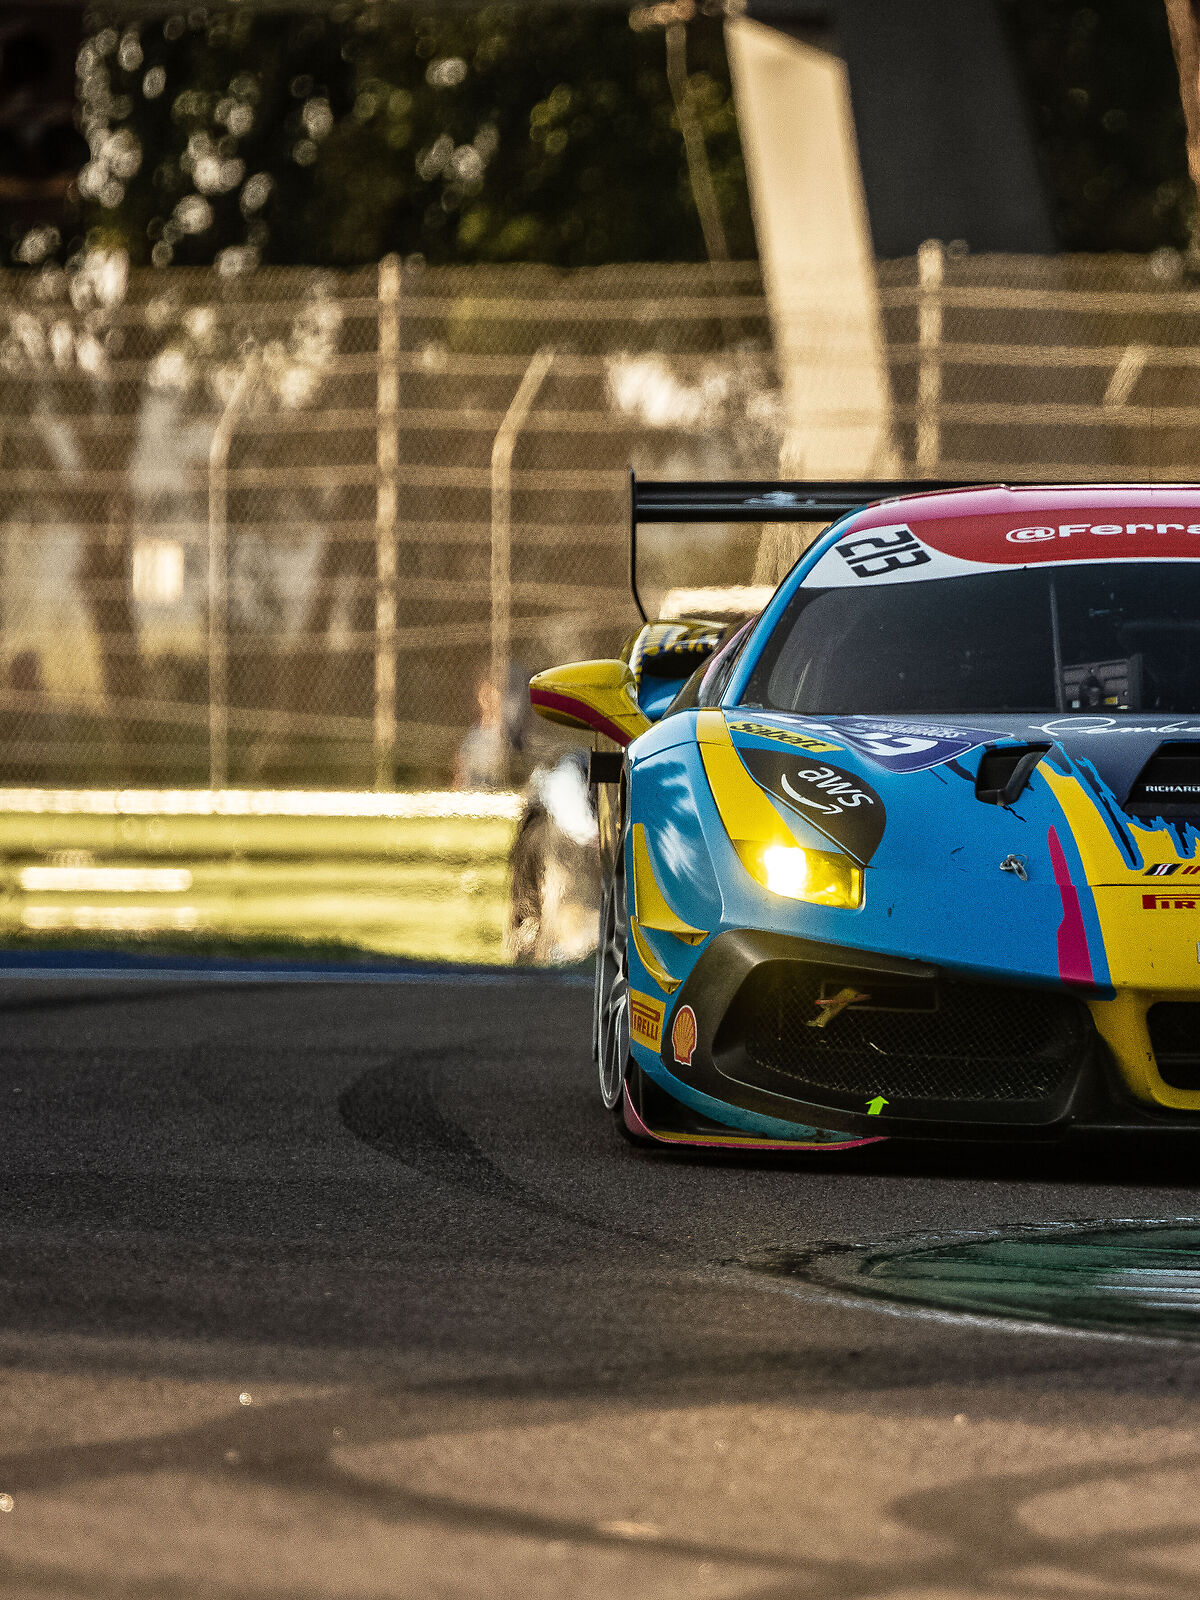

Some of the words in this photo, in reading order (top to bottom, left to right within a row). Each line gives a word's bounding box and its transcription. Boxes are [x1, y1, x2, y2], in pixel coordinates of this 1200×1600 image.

[835, 530, 932, 578] 213
[798, 767, 874, 807] aws
[630, 999, 660, 1041] PIRELLI
